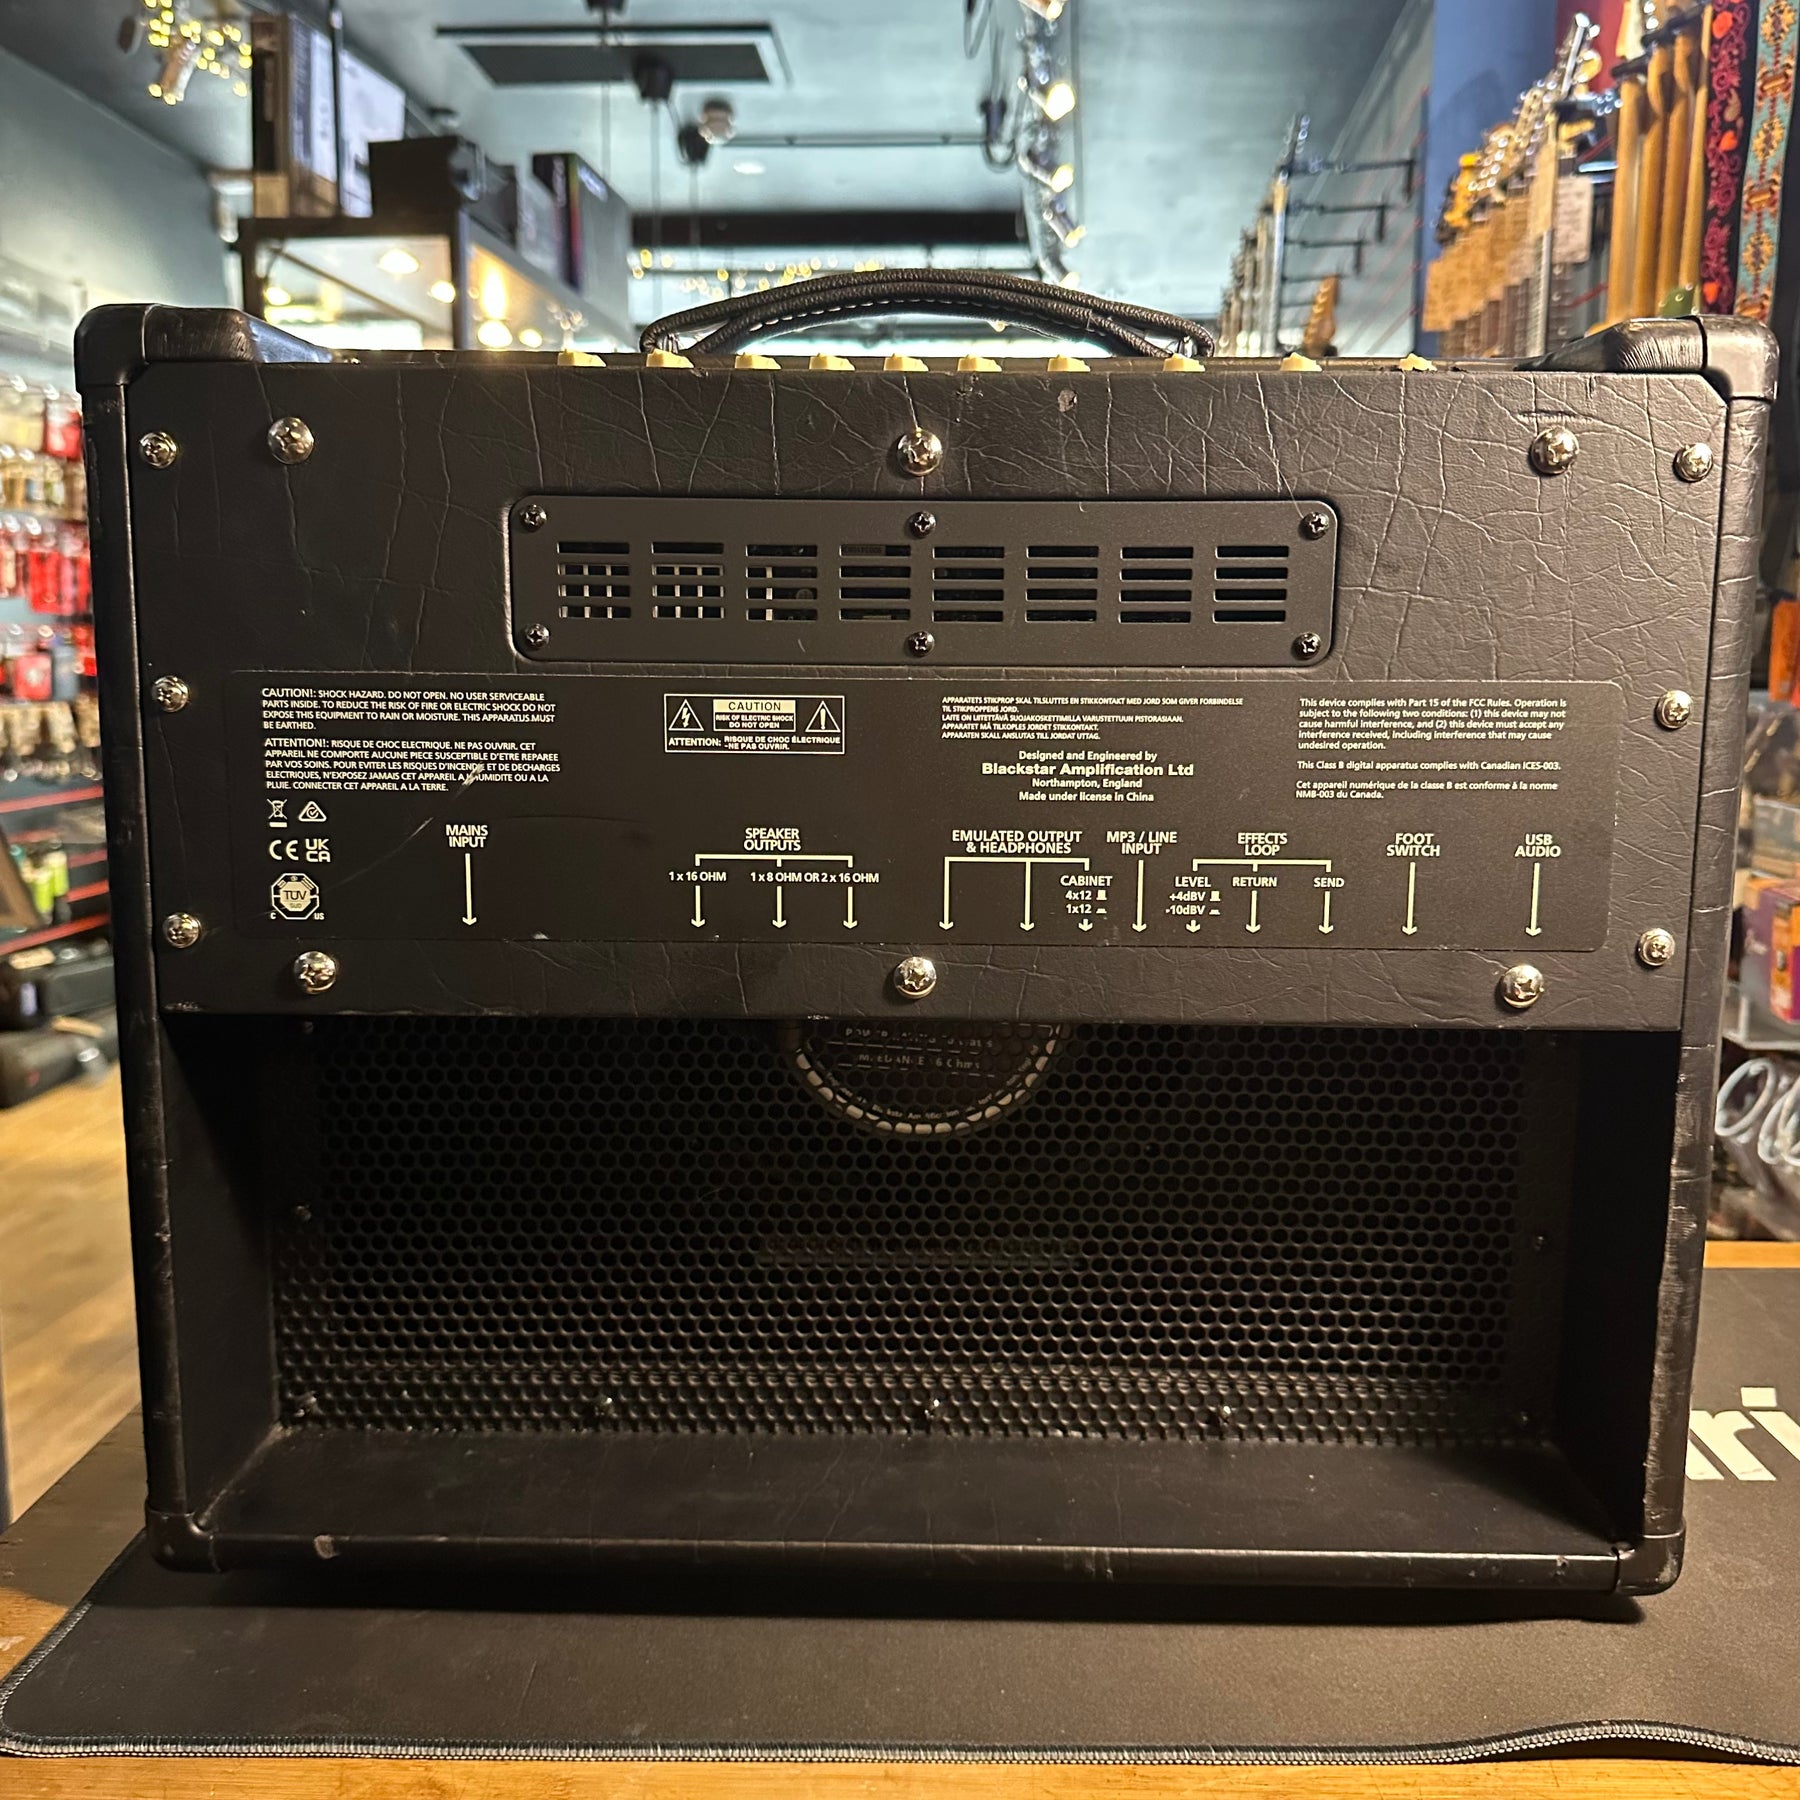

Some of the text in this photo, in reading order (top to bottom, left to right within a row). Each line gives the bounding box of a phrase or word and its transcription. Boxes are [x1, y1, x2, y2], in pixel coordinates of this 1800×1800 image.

[261, 687, 544, 701] CAUTION!: SHOCK HAZARD. DO NOT OPEN. NO USER SERVICEABLE
[262, 700, 556, 712] PARTS INSIDE. TO REDUCE THE RISK OF FIRE OR ELECTRIC SHOCK DO NOT
[728, 701, 781, 711] CAUTION
[1299, 697, 1567, 709] This device complies with Part 15 of the FCC Rules. Operation is
[262, 710, 555, 722] EXPOSE THIS EQUIPMENT TO RAIN OR MOISTURE. THIS APPARATUS MUST
[263, 721, 316, 729] BE EARTHED.
[264, 738, 536, 750] ATTENTION!: RISQUE DE CHOC ELECTRIQUE. NE PAS OUVRIR. CET
[668, 737, 721, 746] ATTENTION:
[724, 735, 753, 743] RISQUE
[1297, 740, 1386, 751] undesired operation.
[1018, 750, 1157, 762] Designed and Engineered by
[982, 762, 1194, 777] Blackstar Amplification Ltd
[1296, 760, 1561, 771] This Class B digital apparatus complies with Canadian ICES-003.
[292, 781, 342, 789] CONNECTER
[360, 782, 399, 790] APPAREIL
[420, 783, 448, 791] TERRE.
[1032, 777, 1142, 789] Northampton, England
[1018, 790, 1154, 801] Made under license in China
[1295, 790, 1384, 798] NMB-003 du Canada.
[445, 824, 488, 836] MAINS
[745, 827, 799, 840] SPEAKER
[448, 836, 486, 847] INPUT
[952, 830, 1082, 843] EMULATED OUTPUT
[1106, 830, 1135, 844] MP3
[1148, 831, 1177, 844] LINE
[1237, 832, 1287, 844] EFFECTS
[1395, 832, 1434, 845] FOOT
[1525, 833, 1553, 845] USB
[269, 839, 299, 860] CE
[305, 838, 329, 850] UK
[743, 839, 801, 850] OUTPUTS
[965, 842, 1071, 853] & HEADPHONES
[1121, 843, 1162, 854] INPUT
[1244, 844, 1280, 856] LOOP
[1386, 844, 1440, 856] SWITCH
[1514, 845, 1561, 857] AUDIO
[306, 851, 331, 862] CA
[668, 871, 674, 880] 1
[685, 871, 698, 881] 16
[699, 871, 726, 881] OHM
[750, 871, 879, 882] 1 x 8 OHM OR 2 x 16 OHM
[1060, 875, 1113, 886] CABINET
[1175, 876, 1211, 887] LEVEL
[1232, 876, 1277, 887] RETURN
[1313, 877, 1344, 887] SEND
[1065, 890, 1091, 900] 4x12
[1169, 891, 1206, 901] +4dBV
[1066, 903, 1091, 913] 1x12
[1165, 904, 1205, 914] -10dBV
